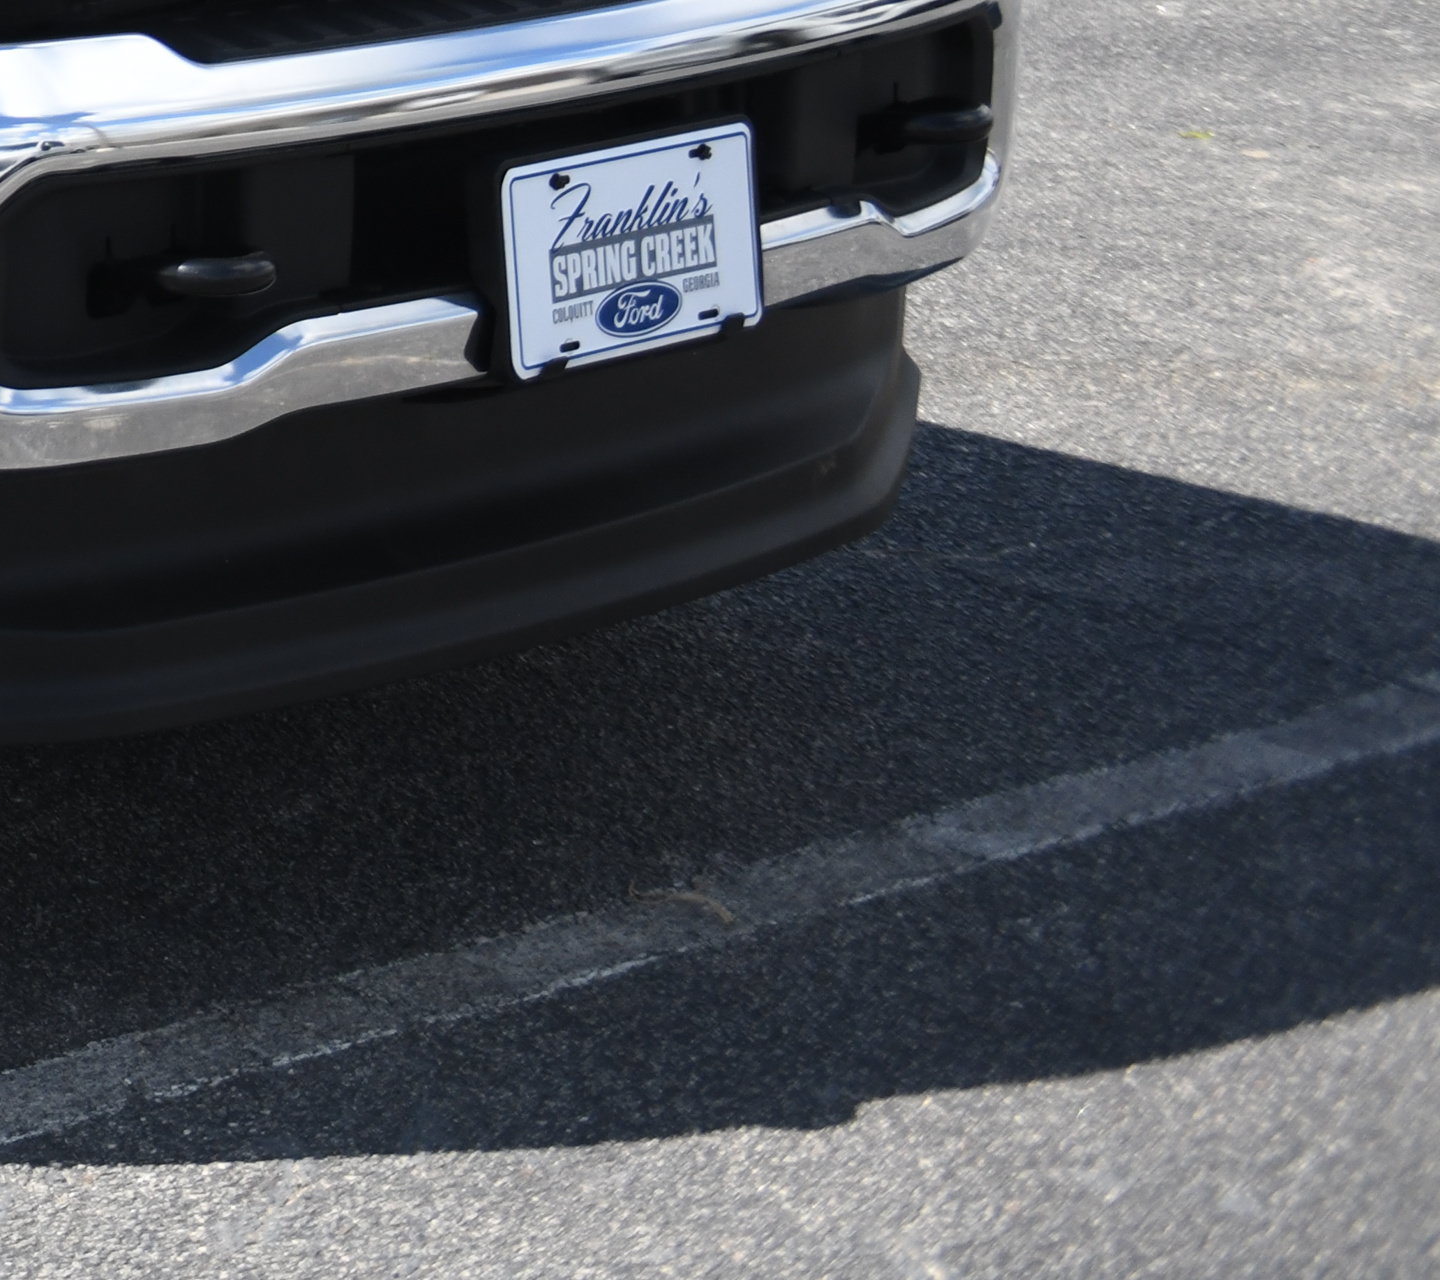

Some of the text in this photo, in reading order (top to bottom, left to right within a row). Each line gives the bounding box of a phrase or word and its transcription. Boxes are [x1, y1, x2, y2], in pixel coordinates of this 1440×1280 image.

[549, 171, 714, 252] Franklin's
[552, 223, 717, 299] SPRING CREEK
[682, 271, 721, 293] GEORGIA
[552, 300, 594, 325] COLQUITT
[612, 292, 664, 330] Ford
